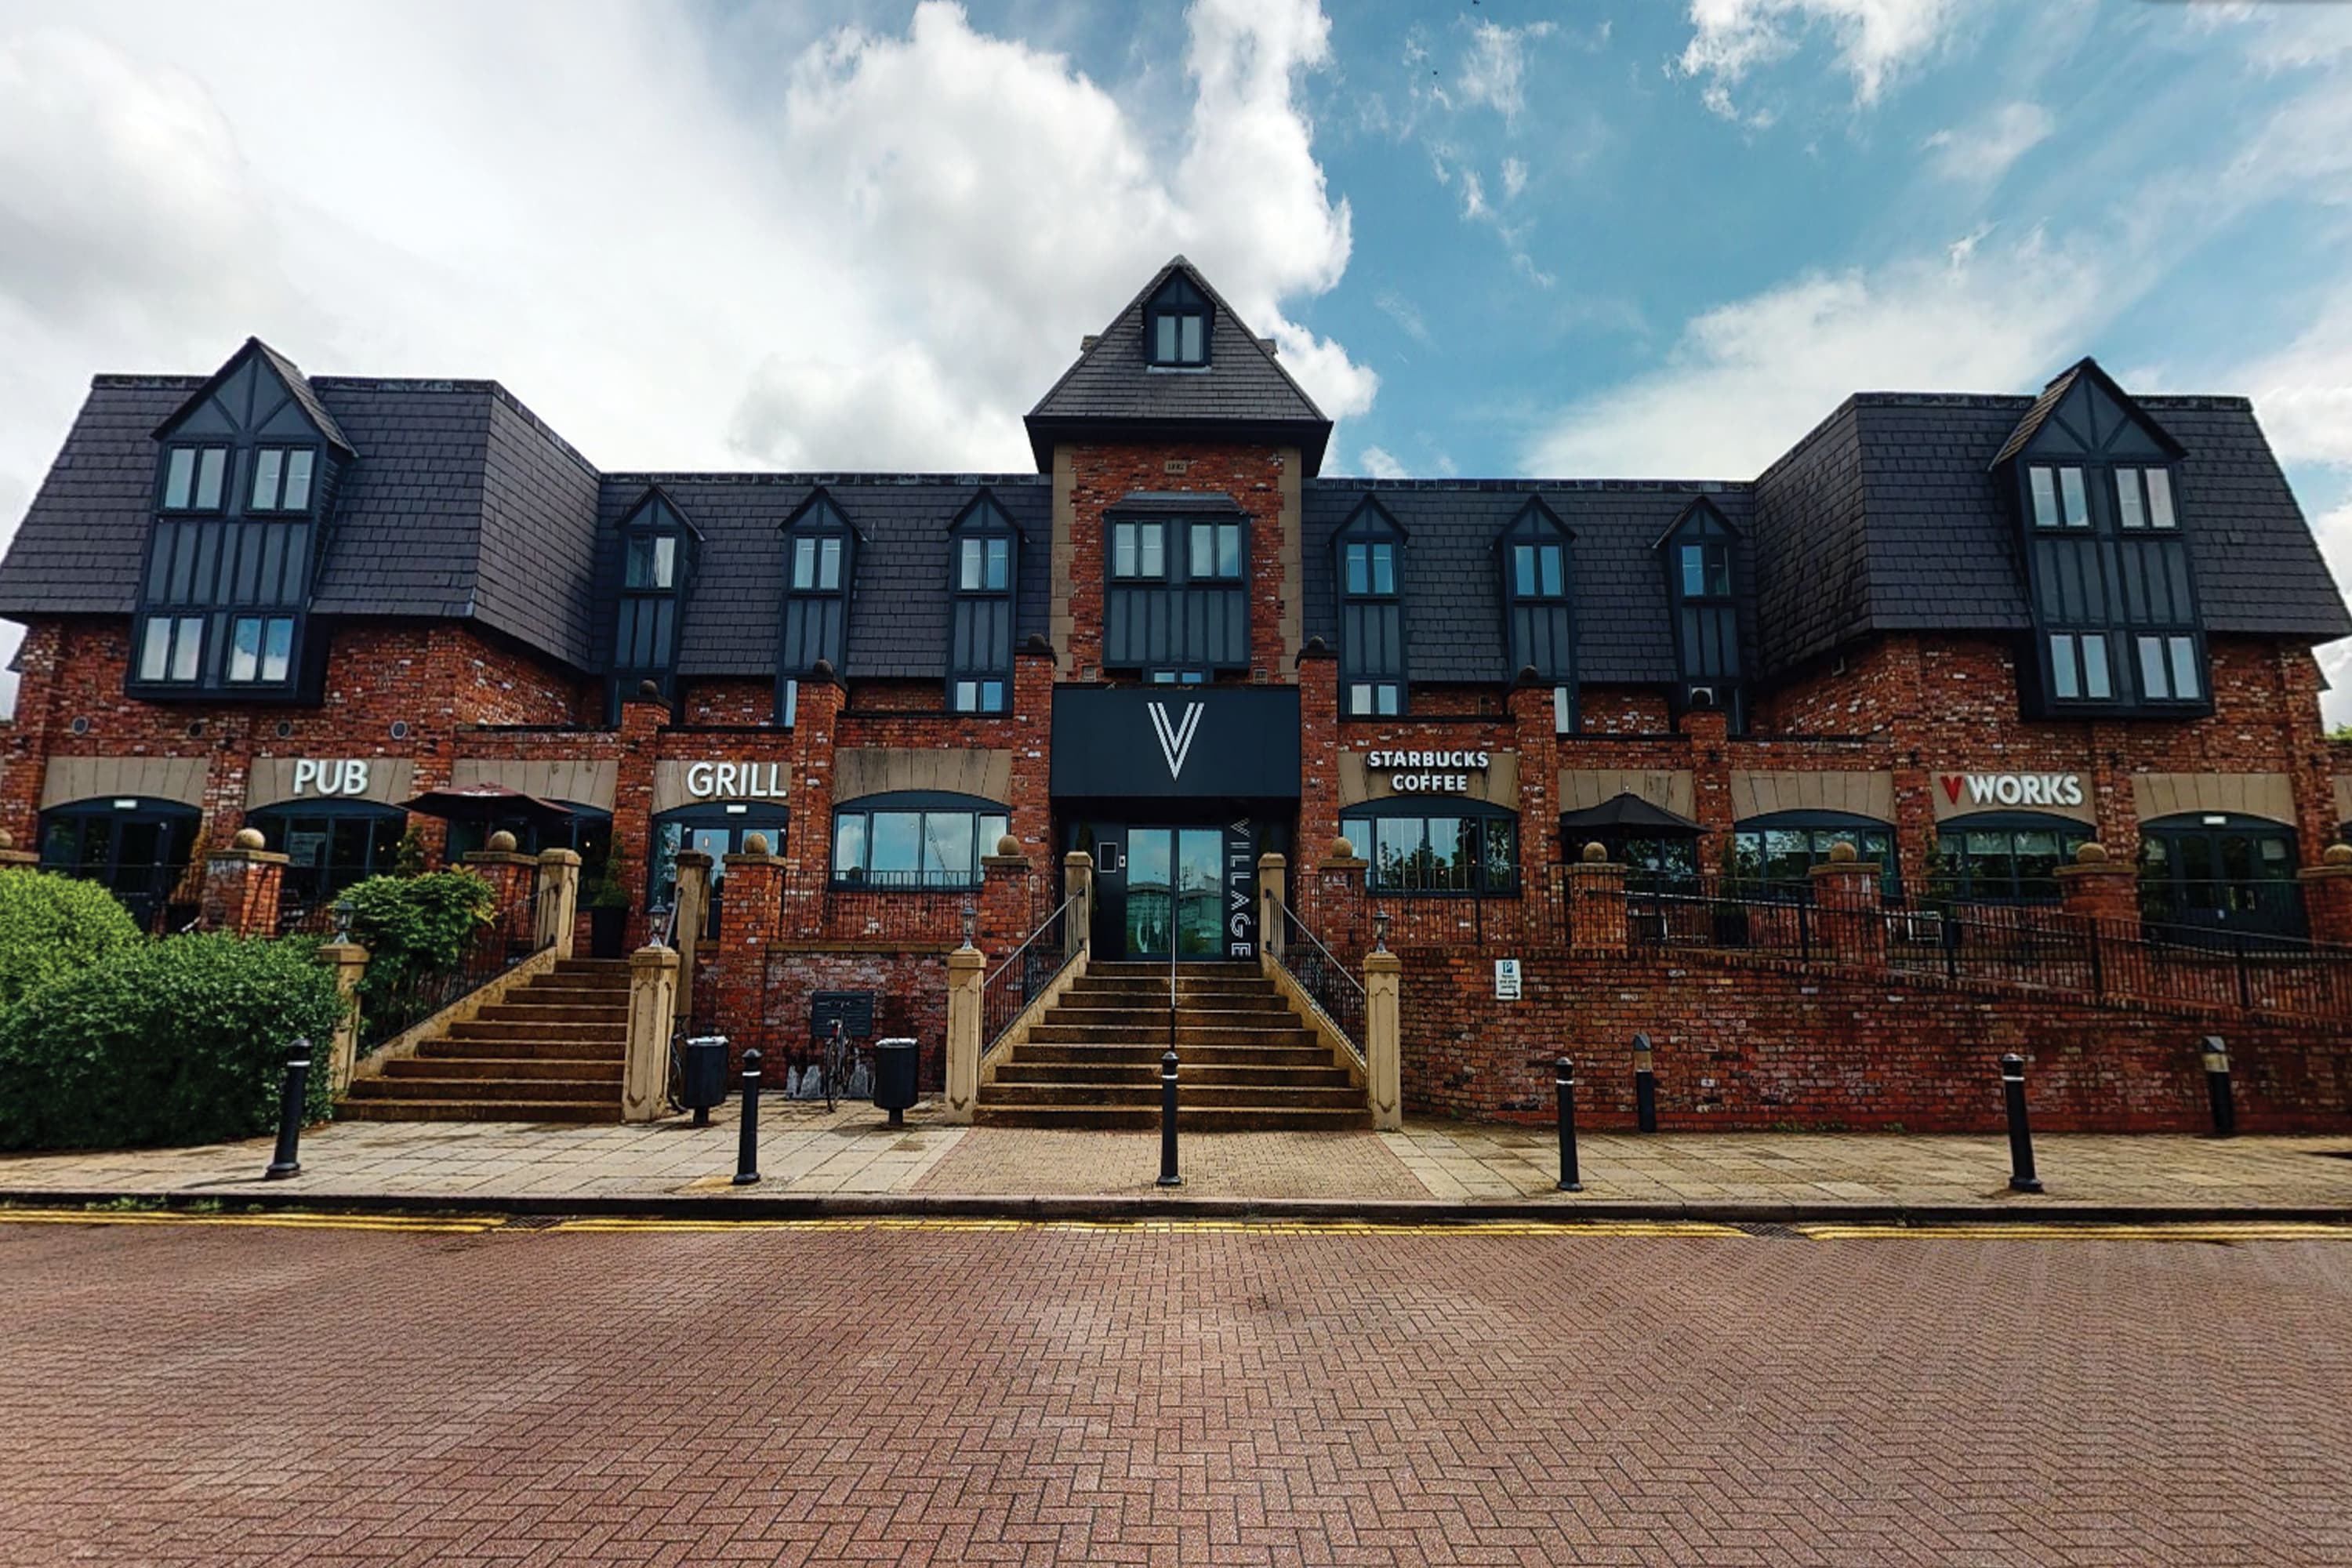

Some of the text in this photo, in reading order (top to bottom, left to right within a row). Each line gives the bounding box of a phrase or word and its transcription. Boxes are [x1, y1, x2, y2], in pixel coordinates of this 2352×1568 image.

[1147, 702, 1205, 781] V
[1370, 750, 1489, 767] STARBUCKS
[294, 759, 368, 794] PUB
[688, 762, 786, 797] GRILL
[1392, 775, 1467, 791] COFFEE
[1230, 818, 1250, 956] VILLAGE
